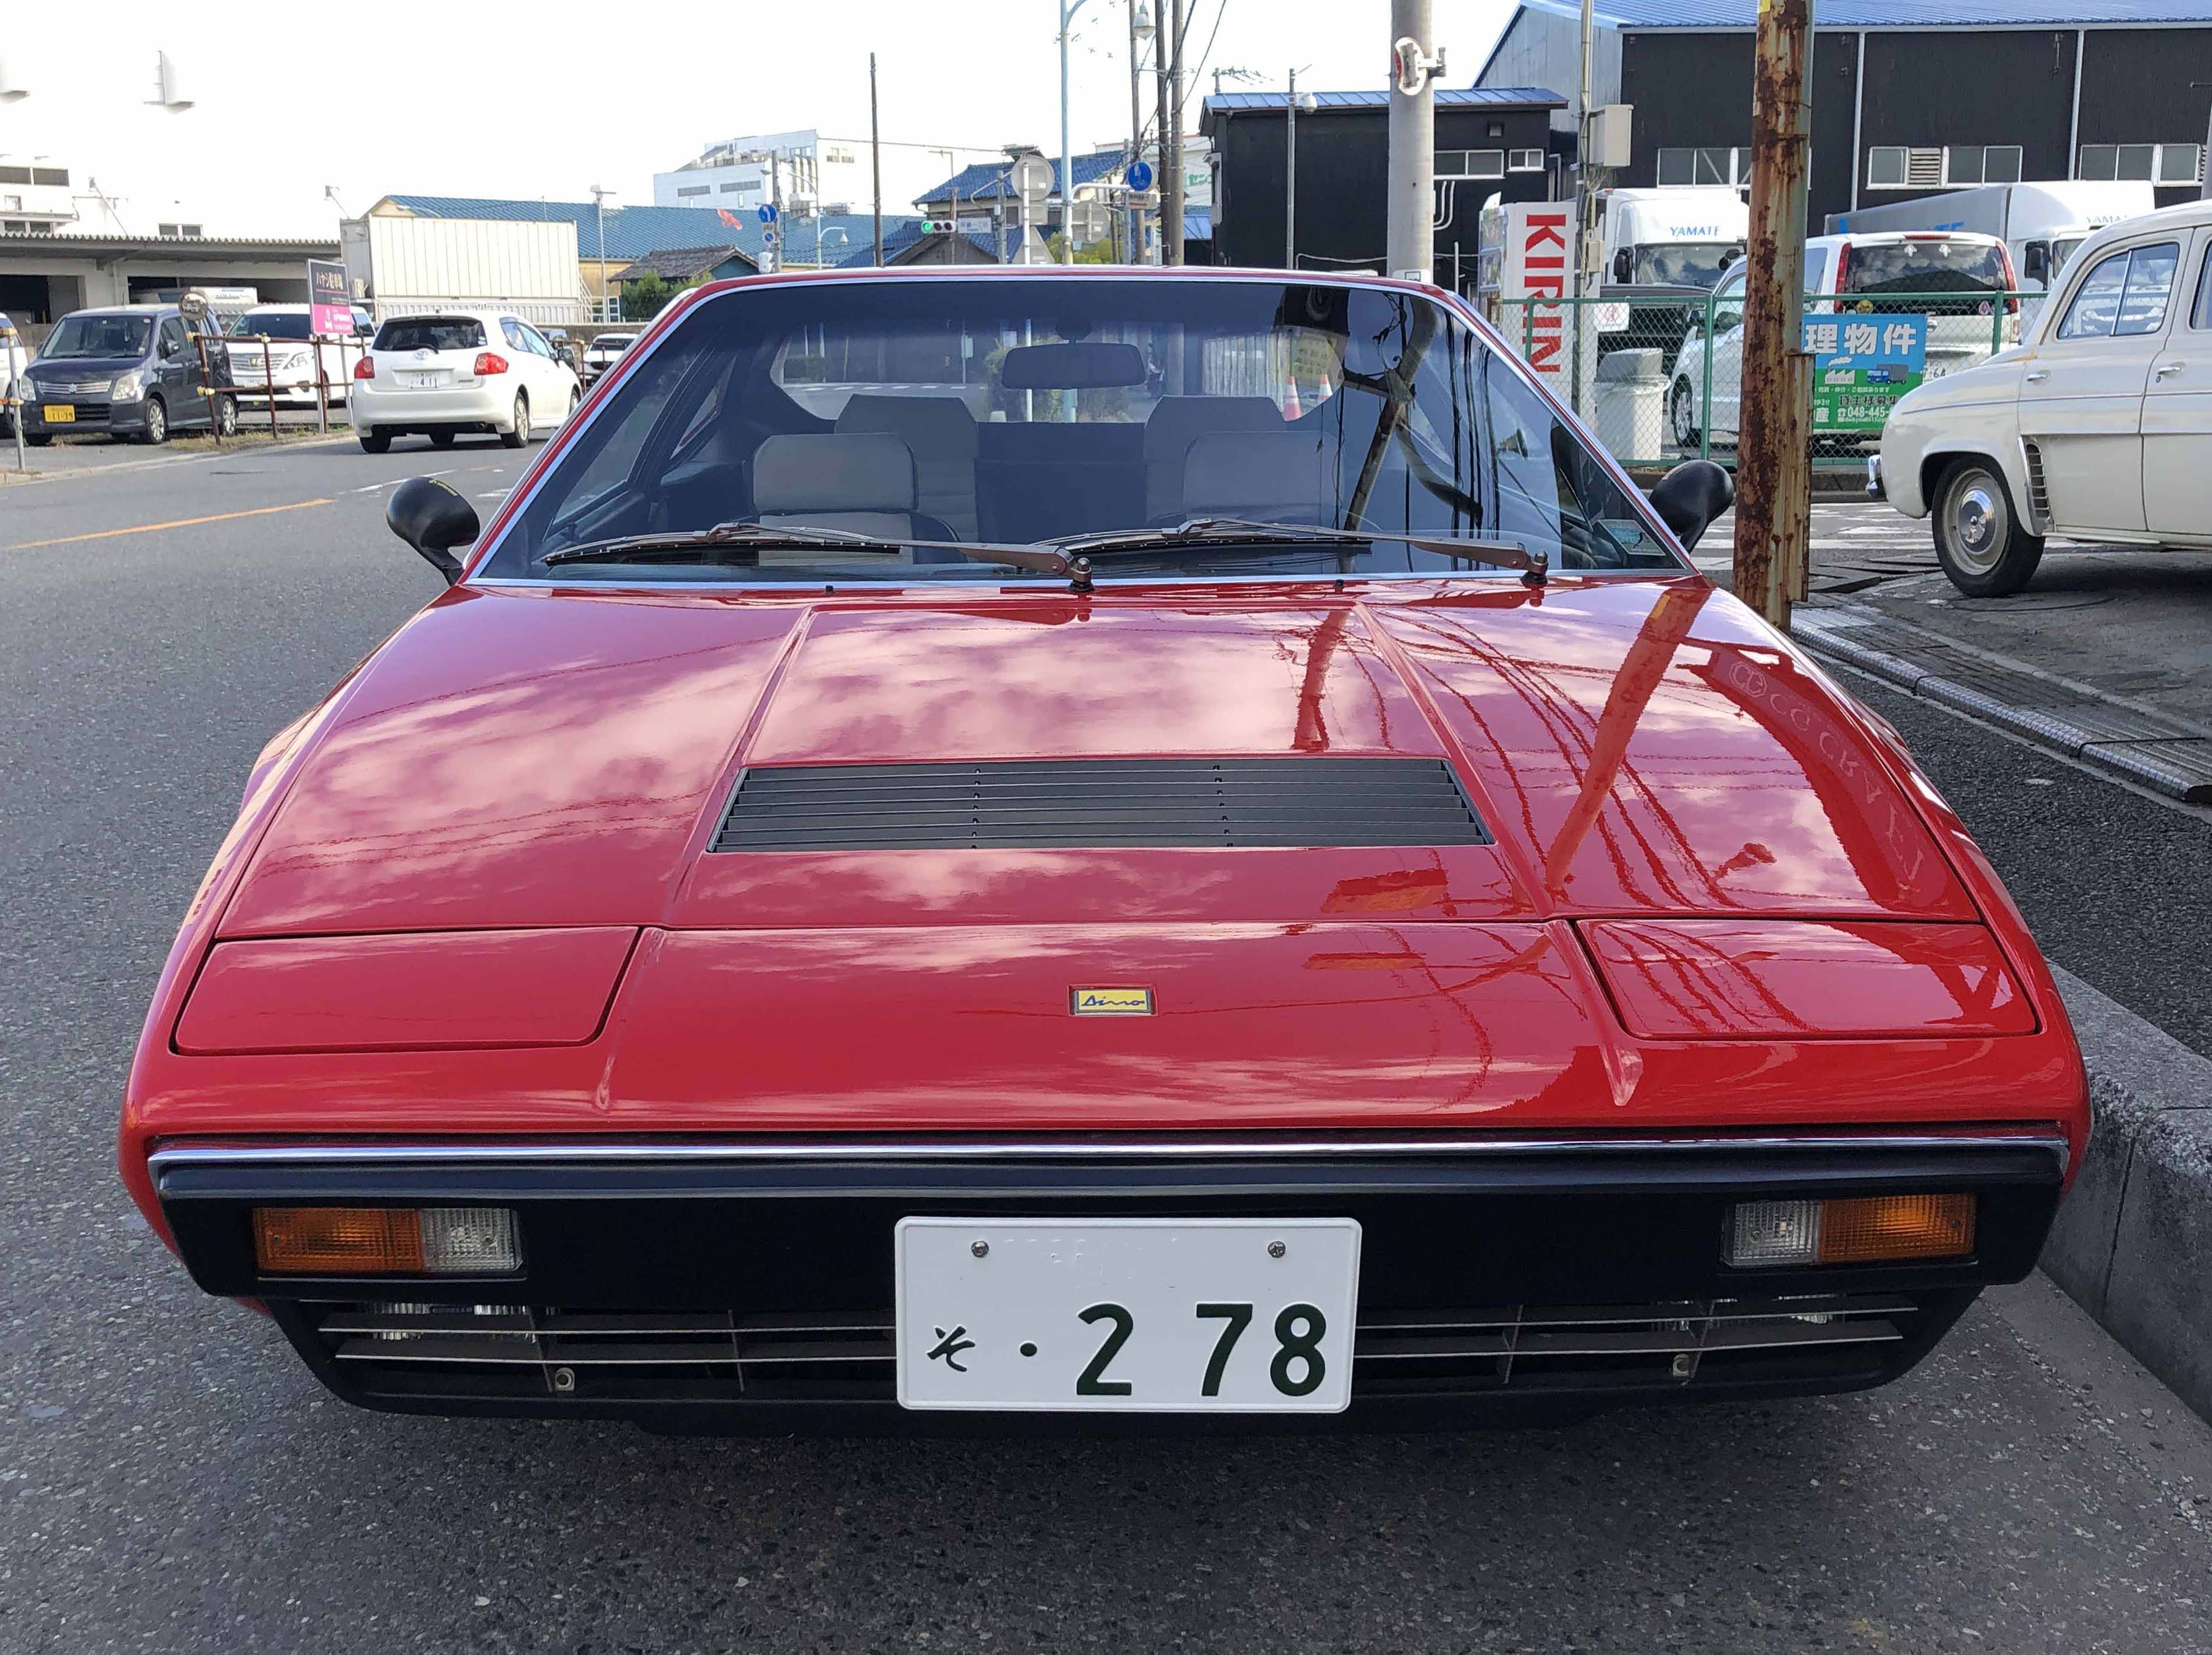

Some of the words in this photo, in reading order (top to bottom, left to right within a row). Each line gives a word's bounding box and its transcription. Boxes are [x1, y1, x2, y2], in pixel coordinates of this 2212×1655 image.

[1522, 214, 1566, 373] KIRIN
[1804, 323, 1917, 355] 理物件
[1081, 995, 1145, 1007] Dino
[927, 1325, 975, 1372] そ
